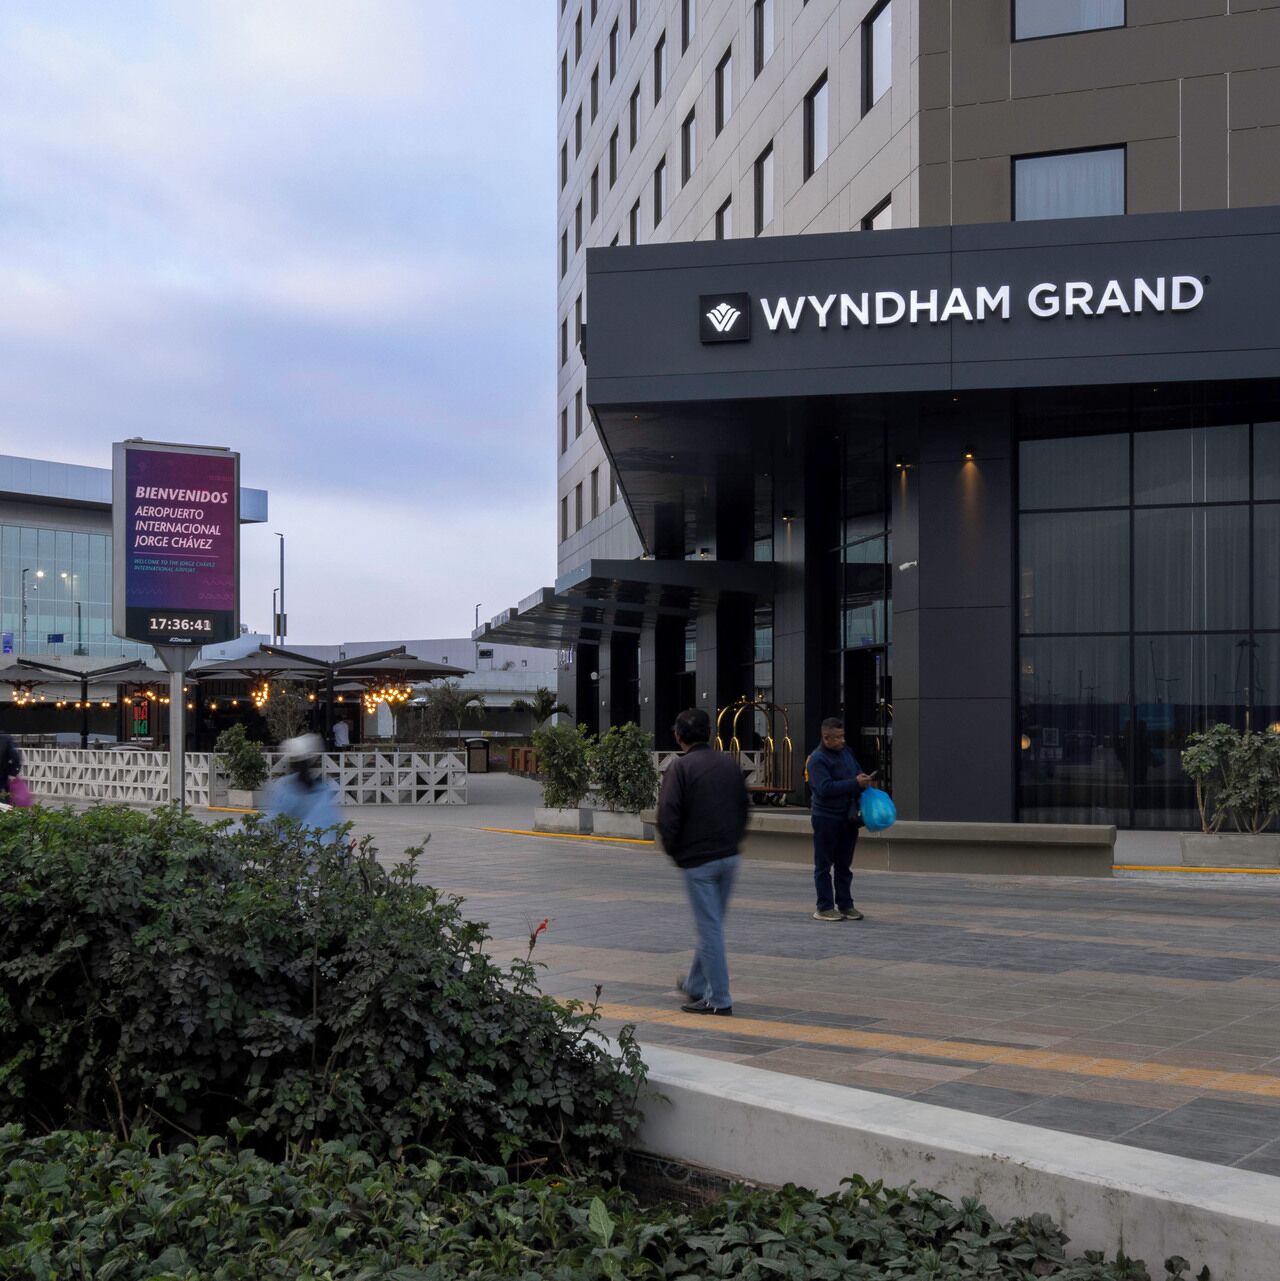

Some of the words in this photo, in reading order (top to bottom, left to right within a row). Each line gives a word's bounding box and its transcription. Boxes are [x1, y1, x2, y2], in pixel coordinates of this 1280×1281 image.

[760, 285, 1010, 331] WYNDHAM
[1027, 275, 1204, 318] GRAND
[136, 486, 229, 504] BIENVENIDOS
[135, 506, 204, 520] AEROPUERTO
[135, 521, 222, 536] INTERNACIONAL
[134, 535, 169, 548] JORGE
[171, 536, 213, 549] CHÁVEZ
[150, 618, 212, 631] 17:36:41
